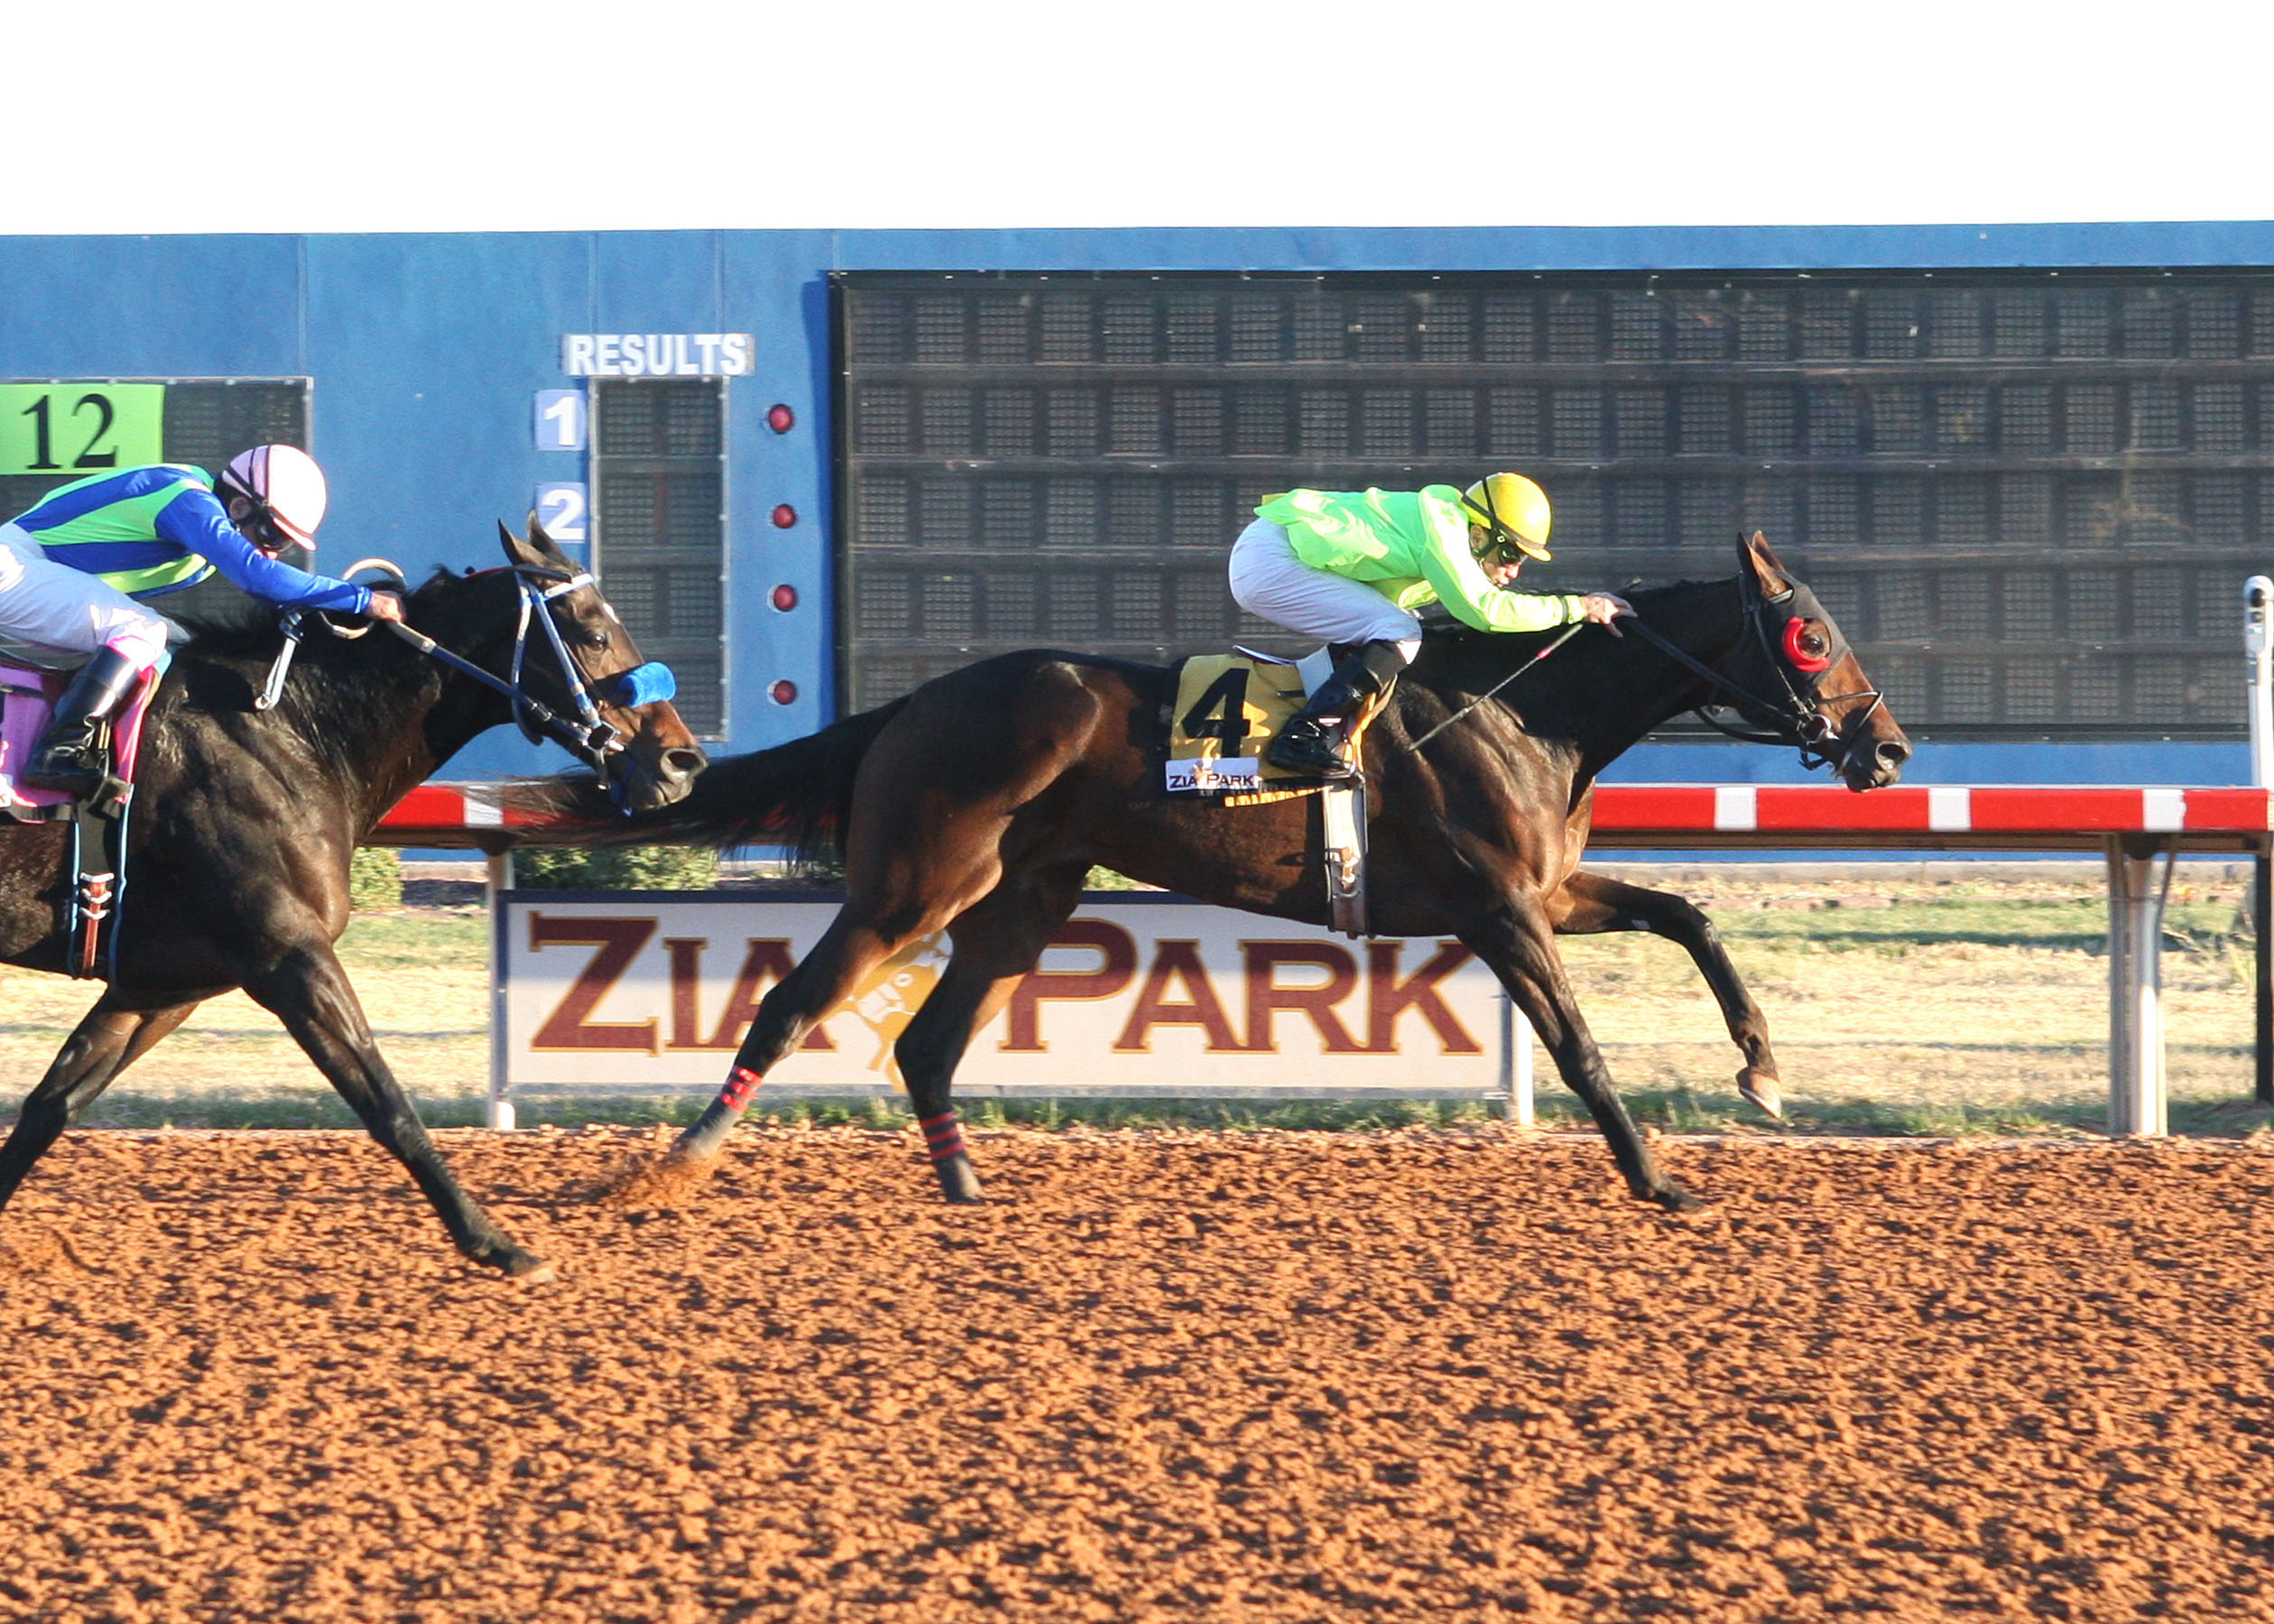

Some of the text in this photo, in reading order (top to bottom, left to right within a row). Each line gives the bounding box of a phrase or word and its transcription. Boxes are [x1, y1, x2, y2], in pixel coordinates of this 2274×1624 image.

[568, 334, 747, 375] RESULTS
[21, 392, 119, 470] 12
[543, 395, 578, 447] 1
[541, 488, 586, 540] 2
[1180, 668, 1251, 758] 4
[1169, 772, 1255, 789] ZIA PARK
[996, 917, 1484, 1057] PARK
